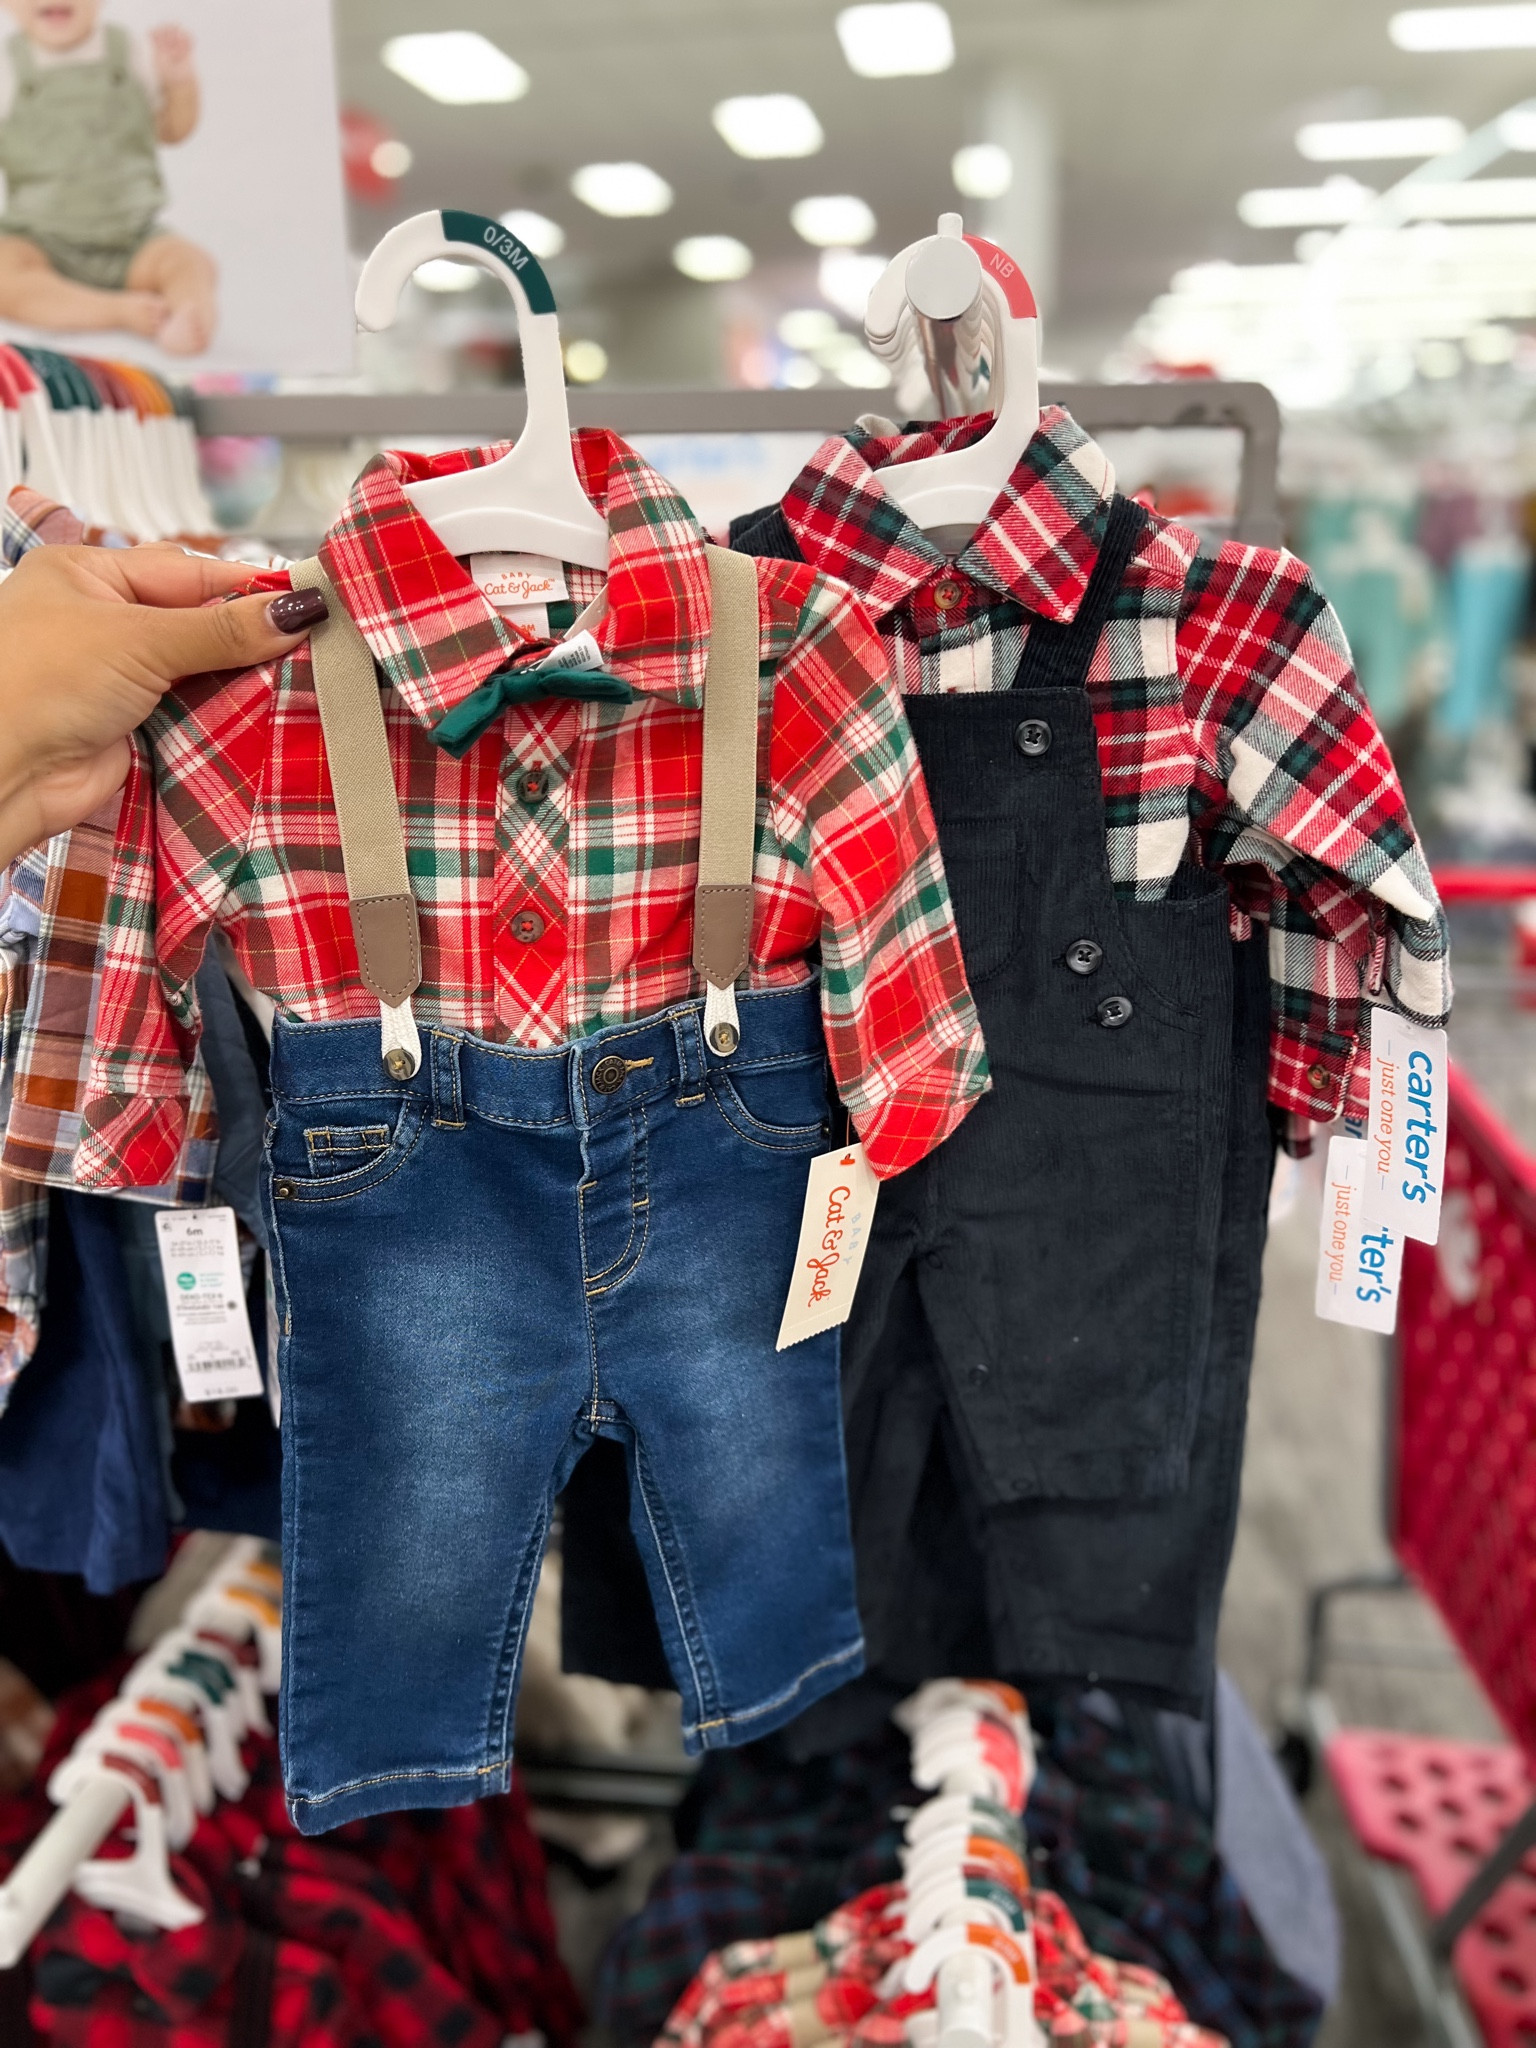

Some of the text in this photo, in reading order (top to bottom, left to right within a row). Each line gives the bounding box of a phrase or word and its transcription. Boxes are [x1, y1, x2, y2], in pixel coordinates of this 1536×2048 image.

[483, 226, 529, 271] 0/3M
[989, 252, 1015, 278] NB
[484, 583, 507, 596] Cat
[507, 582, 521, 594] &
[501, 571, 532, 580] BABY
[1374, 1057, 1400, 1174] just one you
[1402, 1050, 1437, 1204] carter's
[806, 1185, 851, 1308] Cat & Jack
[843, 1212, 862, 1265] BABY
[1325, 1181, 1357, 1282] just one you
[1356, 1227, 1394, 1303] ter's
